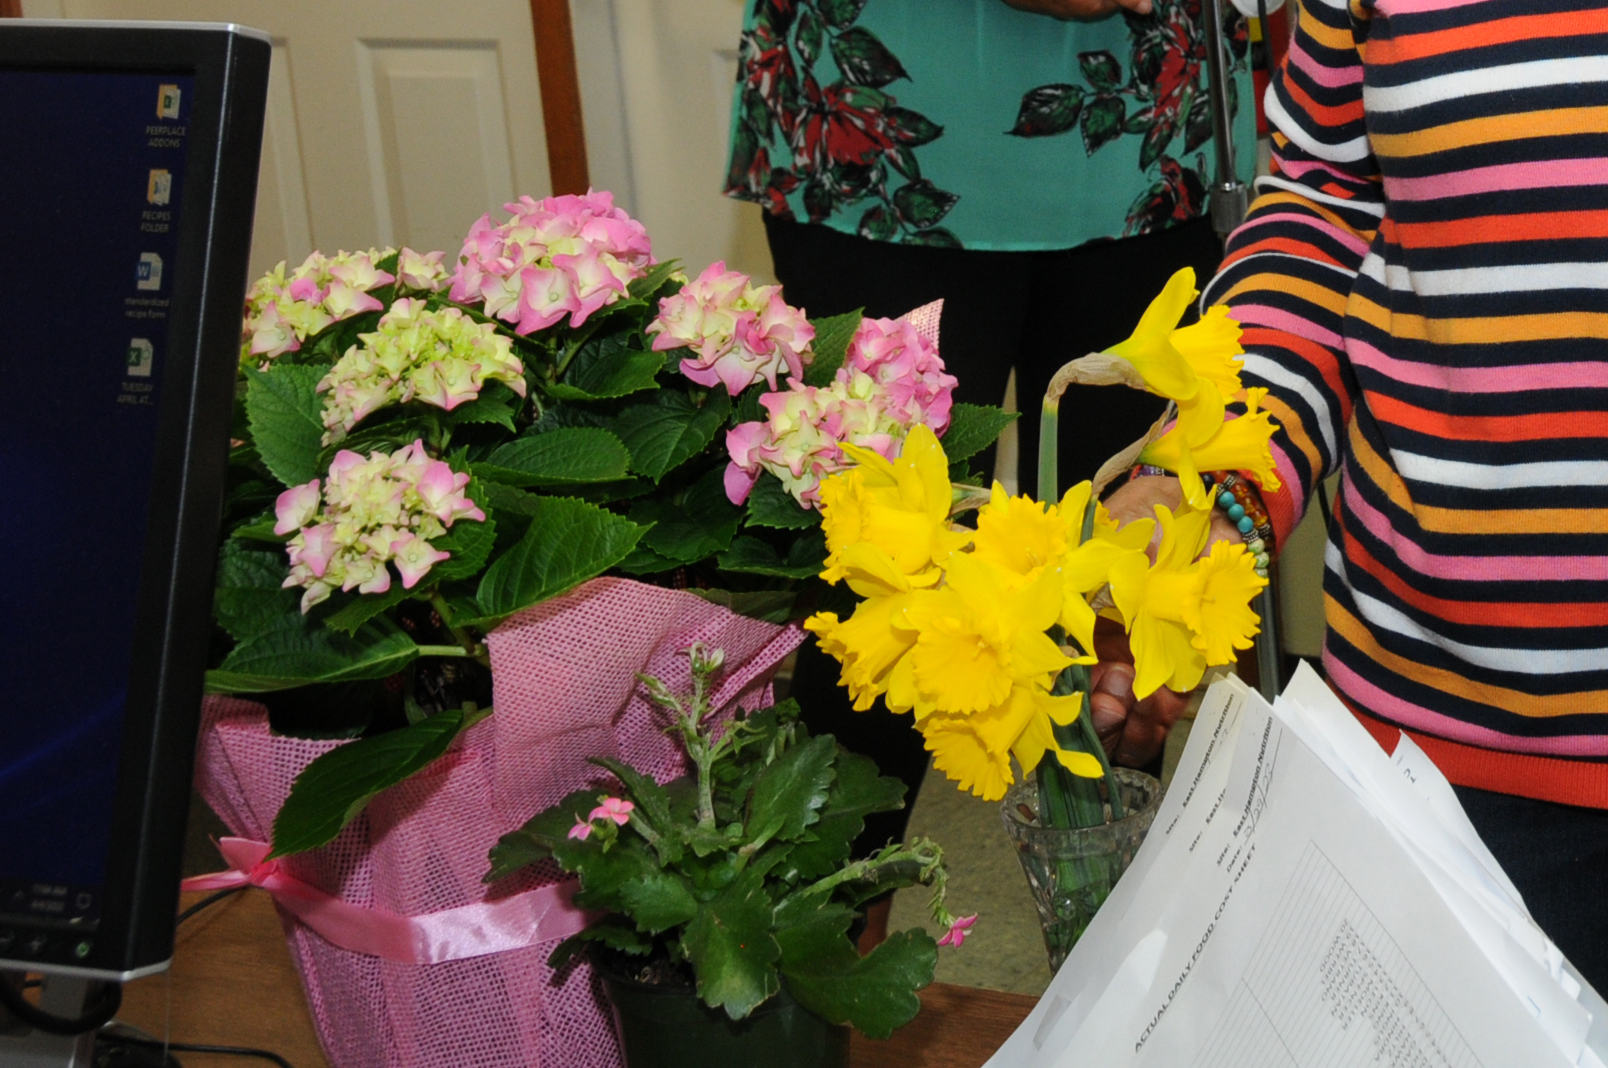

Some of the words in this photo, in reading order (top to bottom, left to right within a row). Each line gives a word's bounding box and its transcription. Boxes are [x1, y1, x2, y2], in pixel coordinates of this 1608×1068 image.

[146, 125, 186, 136] PEERPLACE
[148, 138, 181, 148] ADDONS
[141, 223, 169, 233] FOLDER
[142, 211, 171, 221] RECIPES
[121, 382, 154, 392] TUESDAY
[1166, 814, 1180, 835] Site:
[1182, 787, 1195, 808] East
[1193, 739, 1216, 787] Hampton
[1213, 693, 1235, 738] Nutrition
[1216, 843, 1230, 867] Site:
[1232, 815, 1246, 838] East
[1243, 765, 1262, 816] Hampton
[1257, 716, 1274, 764] Nutrition
[1189, 830, 1203, 853] Site:
[1205, 804, 1218, 825] East
[1226, 845, 1243, 873] Date:
[1135, 1003, 1169, 1054] ACTUAL
[1168, 962, 1193, 1002] DAILY
[1191, 922, 1215, 963] FOOD
[1214, 885, 1233, 921] COST
[1234, 843, 1256, 884] SHEET
[1319, 934, 1340, 972] WOOD
[1321, 947, 1350, 1003] VETRANO
[1331, 956, 1355, 1002] TURNER
[1339, 969, 1367, 1022] SPENCER
[1360, 985, 1377, 1017] LEON
[1373, 1001, 1388, 1030] KING
